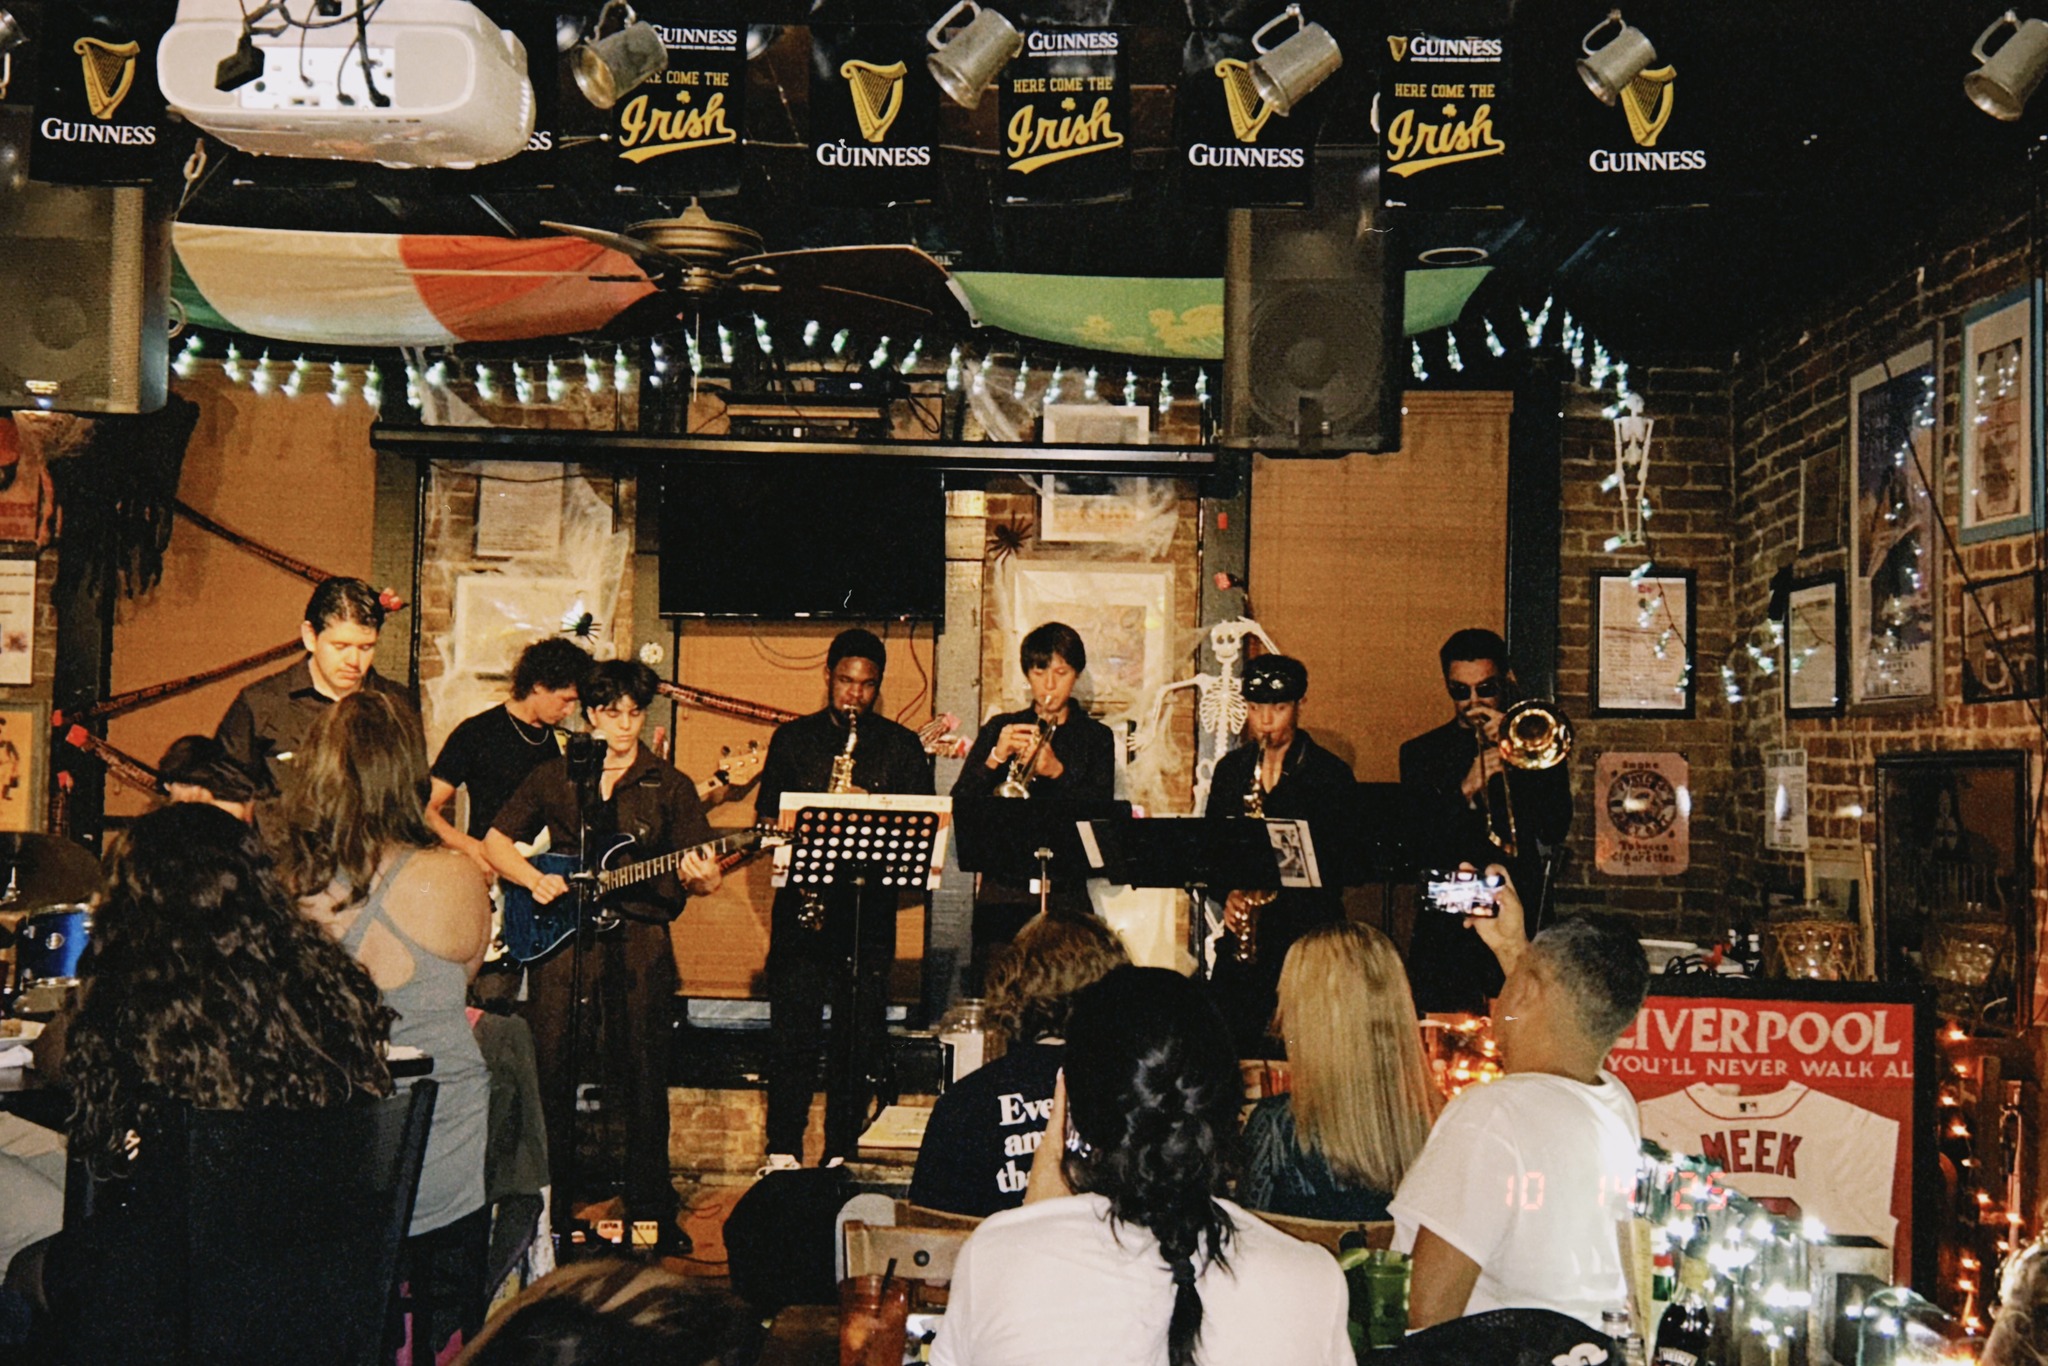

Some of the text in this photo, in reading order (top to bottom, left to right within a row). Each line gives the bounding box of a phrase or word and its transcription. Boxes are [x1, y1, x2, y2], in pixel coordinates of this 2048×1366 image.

[1027, 32, 1119, 51] GUINNESS
[1410, 36, 1503, 56] GUINNESS
[666, 70, 700, 86] COME
[704, 71, 730, 87] THE
[1013, 76, 1113, 94] HERE COME THE
[1395, 83, 1496, 98] HERE COME THE
[41, 117, 156, 146] GUINNESS
[618, 91, 737, 163] Irish
[1007, 97, 1124, 175] Irish
[1387, 104, 1505, 178] Irish
[816, 142, 931, 167] GUINNESS
[1188, 143, 1304, 168] GUINNESS
[1589, 149, 1707, 172] GUINNESS
[1608, 1055, 1913, 1079] YOU'LL NEVER WALK AL
[1701, 1129, 1802, 1179] MEEK
